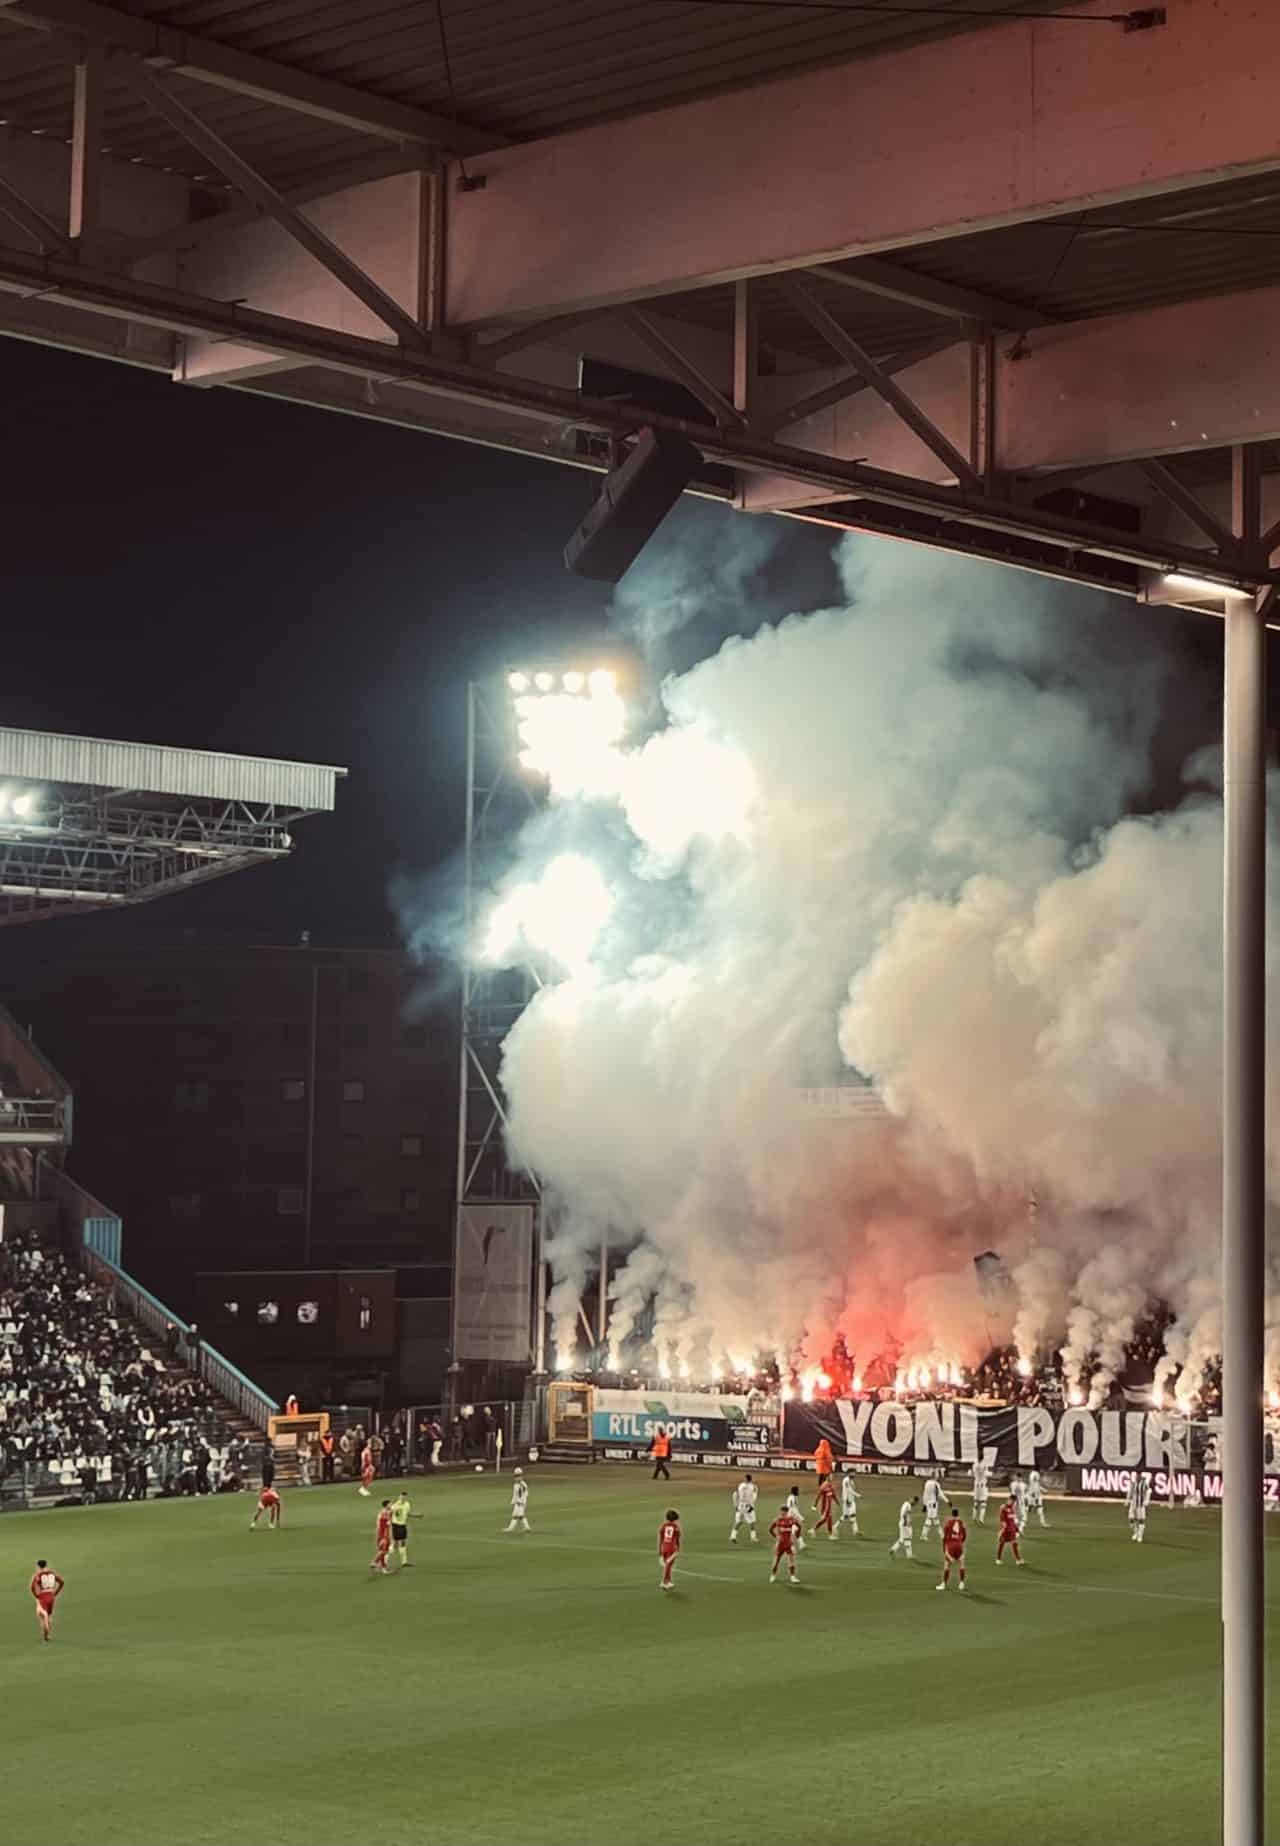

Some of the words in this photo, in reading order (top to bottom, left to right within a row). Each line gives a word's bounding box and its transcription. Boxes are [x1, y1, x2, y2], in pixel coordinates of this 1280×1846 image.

[608, 1414, 641, 1436] RTL
[835, 1400, 998, 1467] YONI,
[1017, 1406, 1190, 1468] POUR
